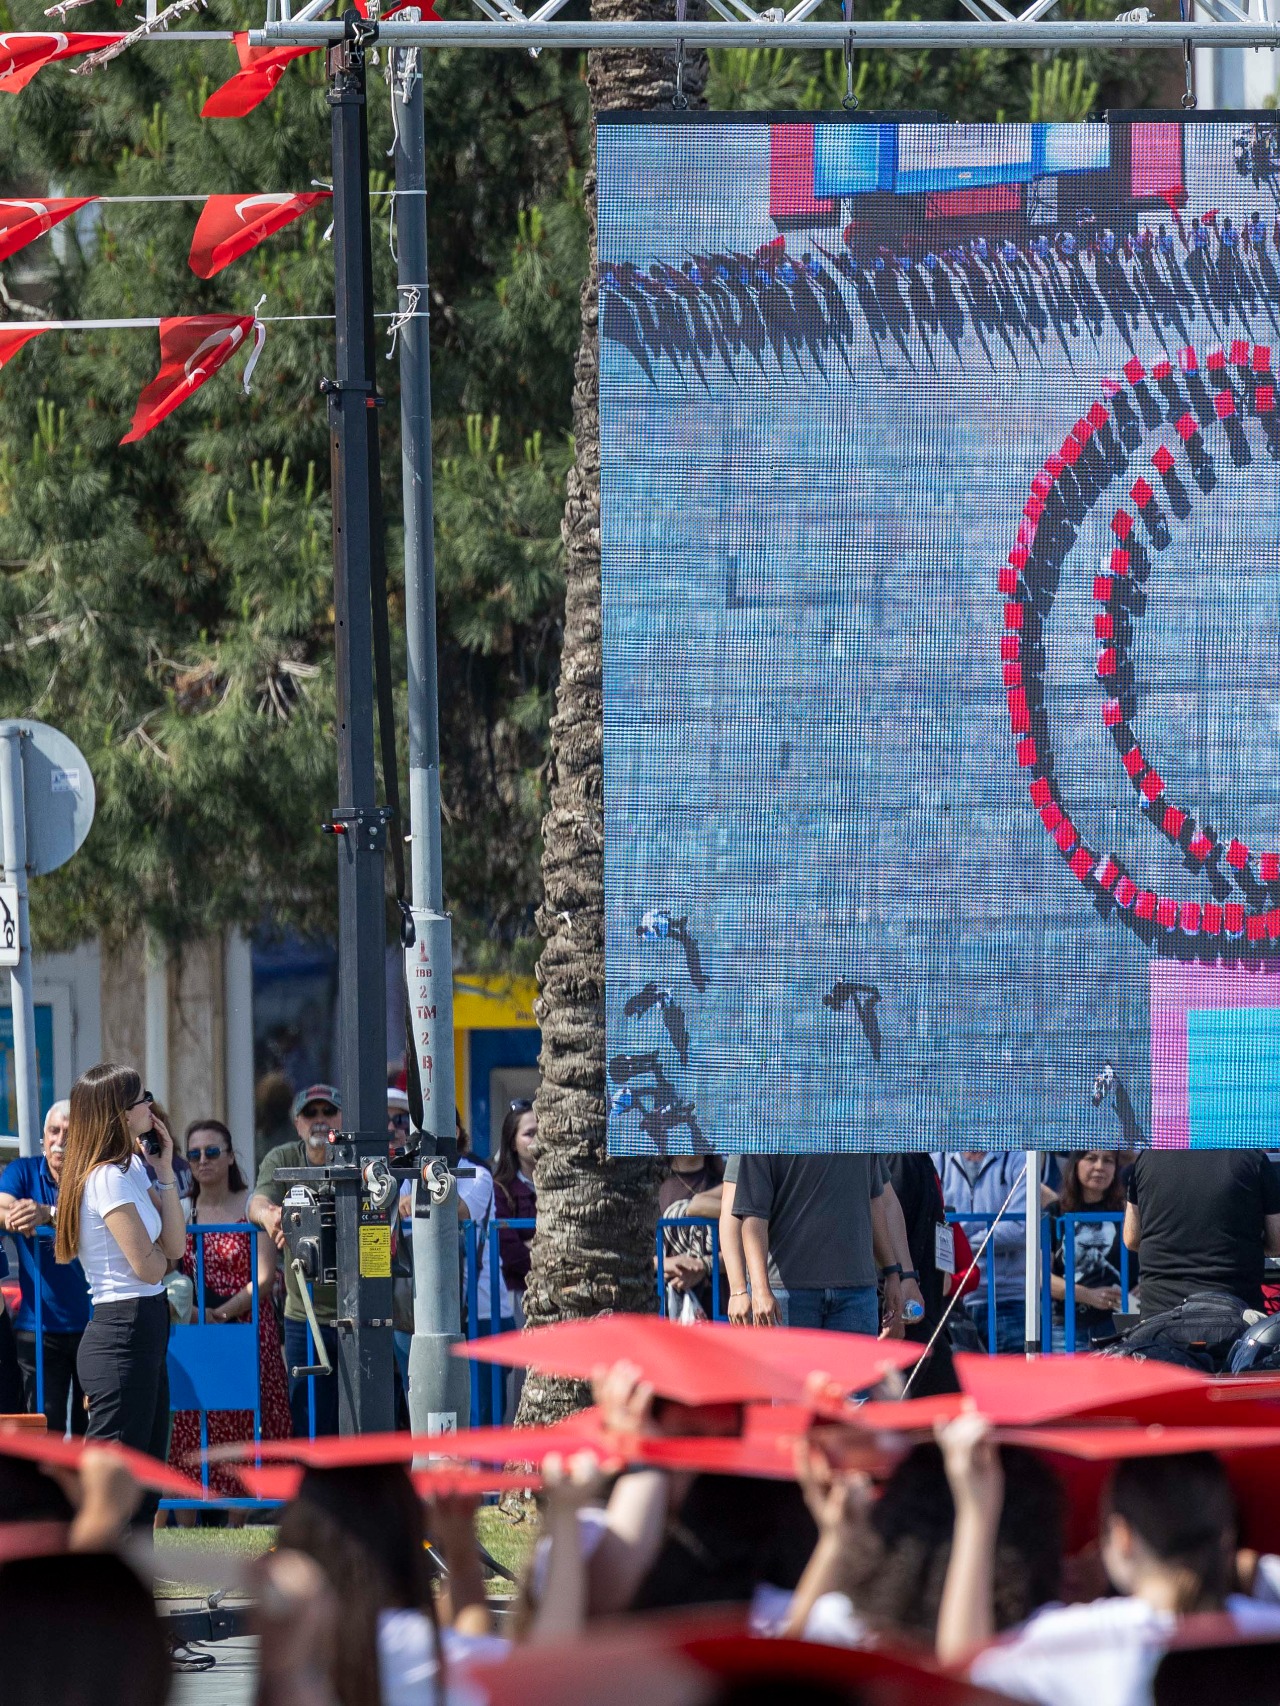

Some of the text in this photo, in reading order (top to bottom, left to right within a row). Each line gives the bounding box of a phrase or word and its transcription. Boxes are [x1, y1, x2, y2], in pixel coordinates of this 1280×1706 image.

[419, 985, 428, 999] 2
[416, 1005, 437, 1020] TM
[421, 1031, 430, 1045] 2
[423, 1087, 431, 1101] 2
